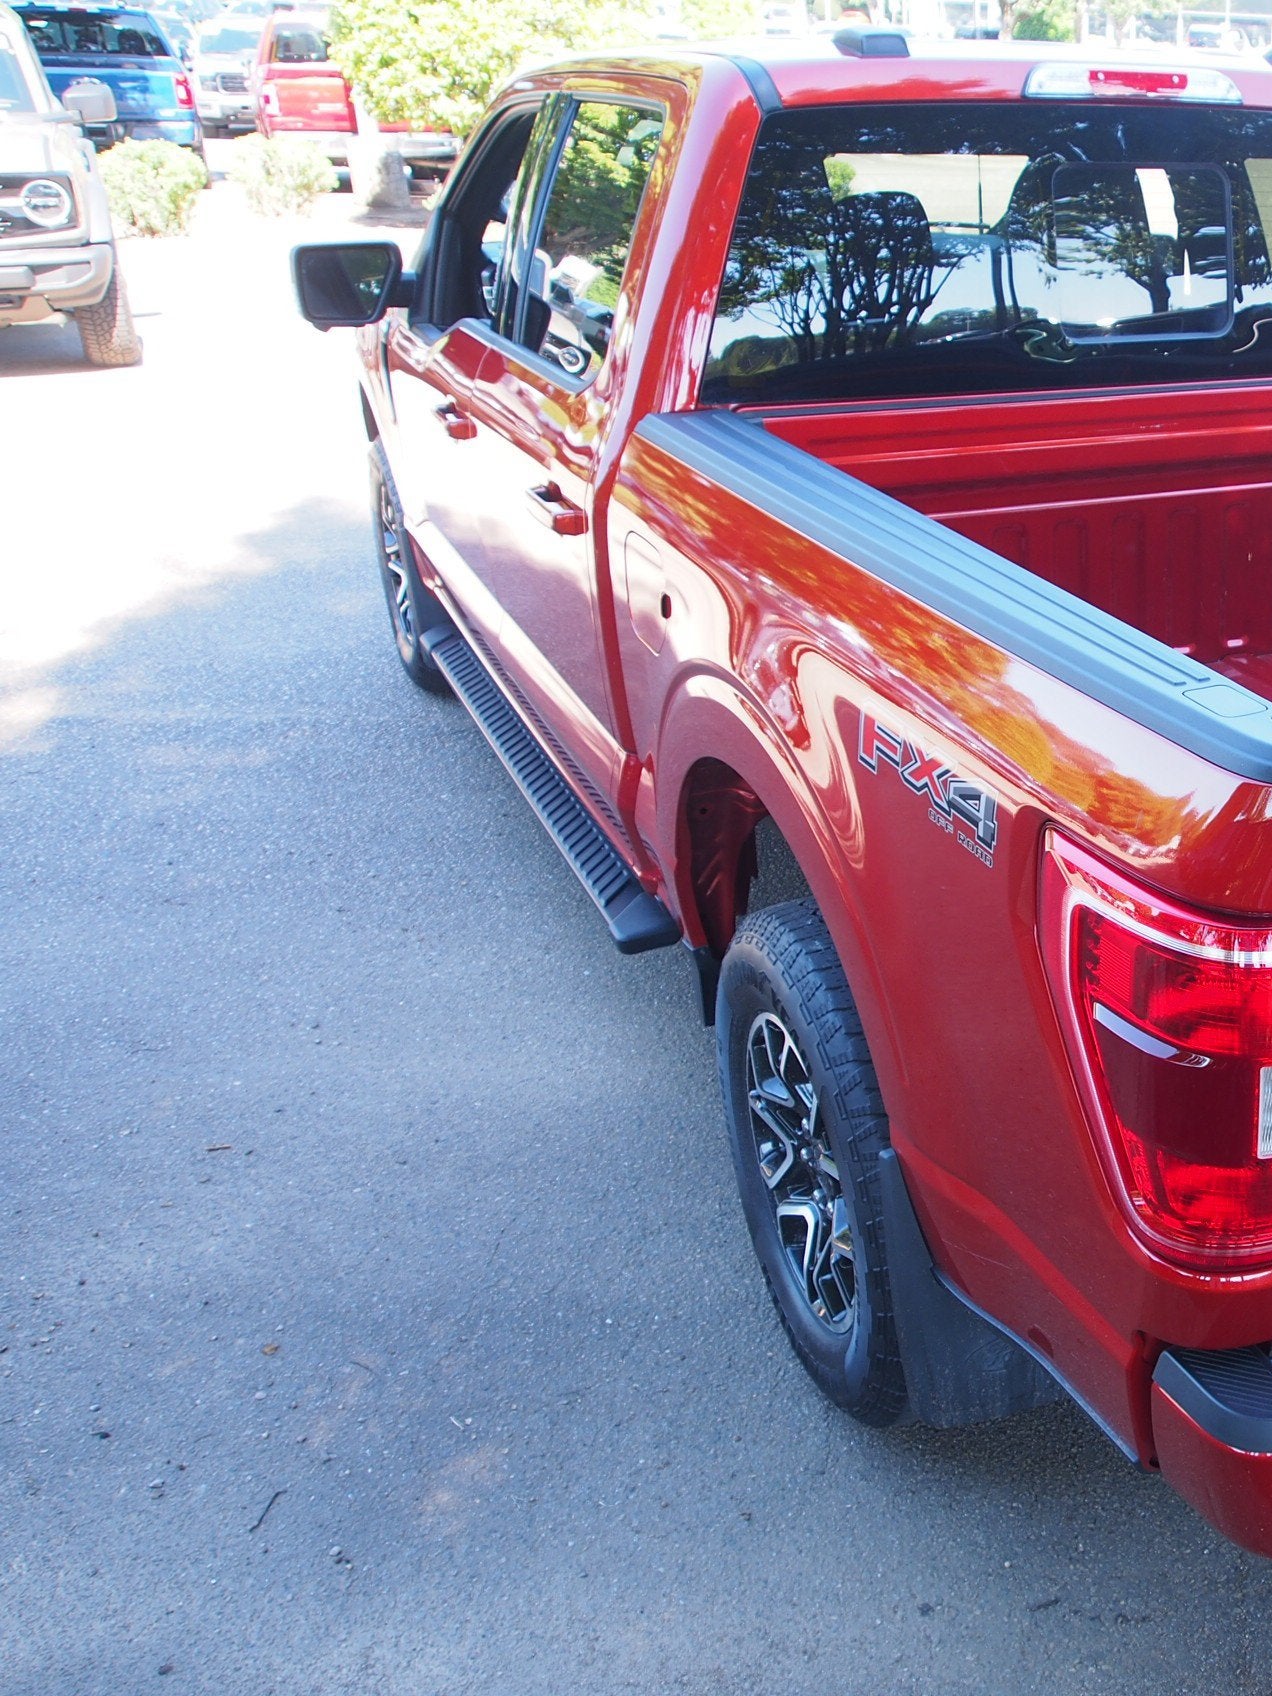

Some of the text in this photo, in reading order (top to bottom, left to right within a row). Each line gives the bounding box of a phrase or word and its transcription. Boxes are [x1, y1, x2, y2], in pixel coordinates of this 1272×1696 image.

[857, 702, 999, 853] FX4
[928, 808, 993, 868] OFF ROAD
